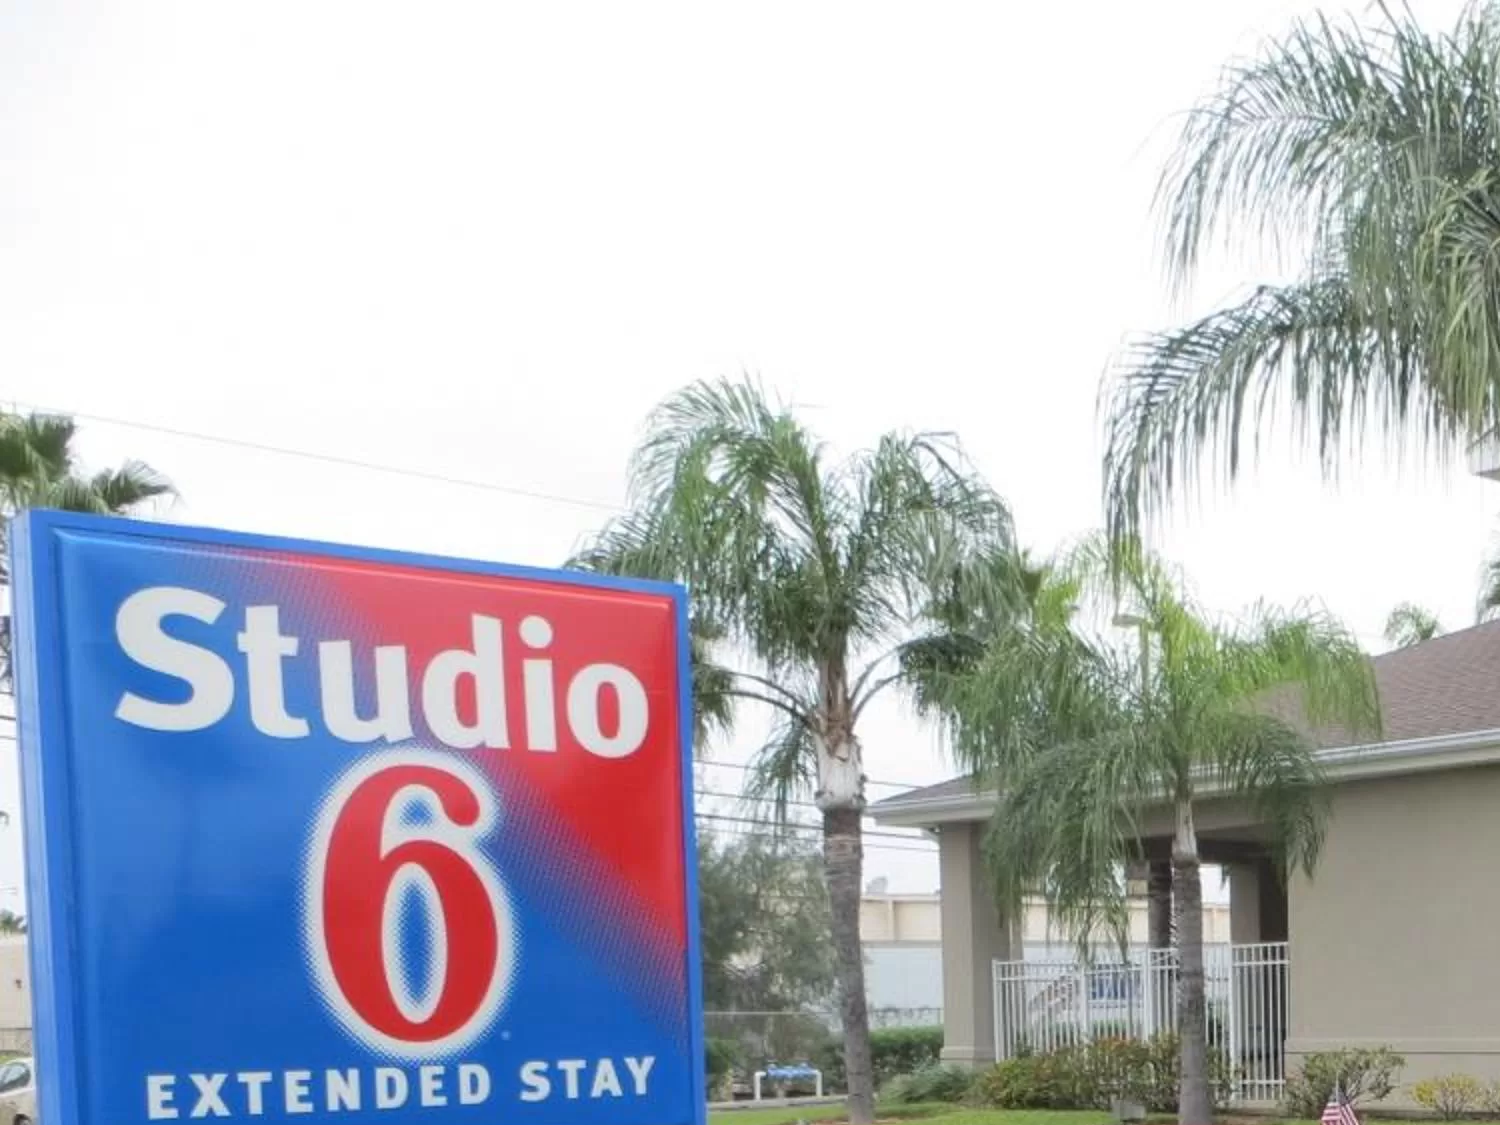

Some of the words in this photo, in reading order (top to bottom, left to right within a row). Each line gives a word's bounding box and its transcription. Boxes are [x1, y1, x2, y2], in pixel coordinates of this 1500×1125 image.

[114, 586, 650, 758] Studio
[321, 763, 500, 1044] 6
[146, 1064, 491, 1120] EXTENDED
[520, 1057, 656, 1102] STAY
